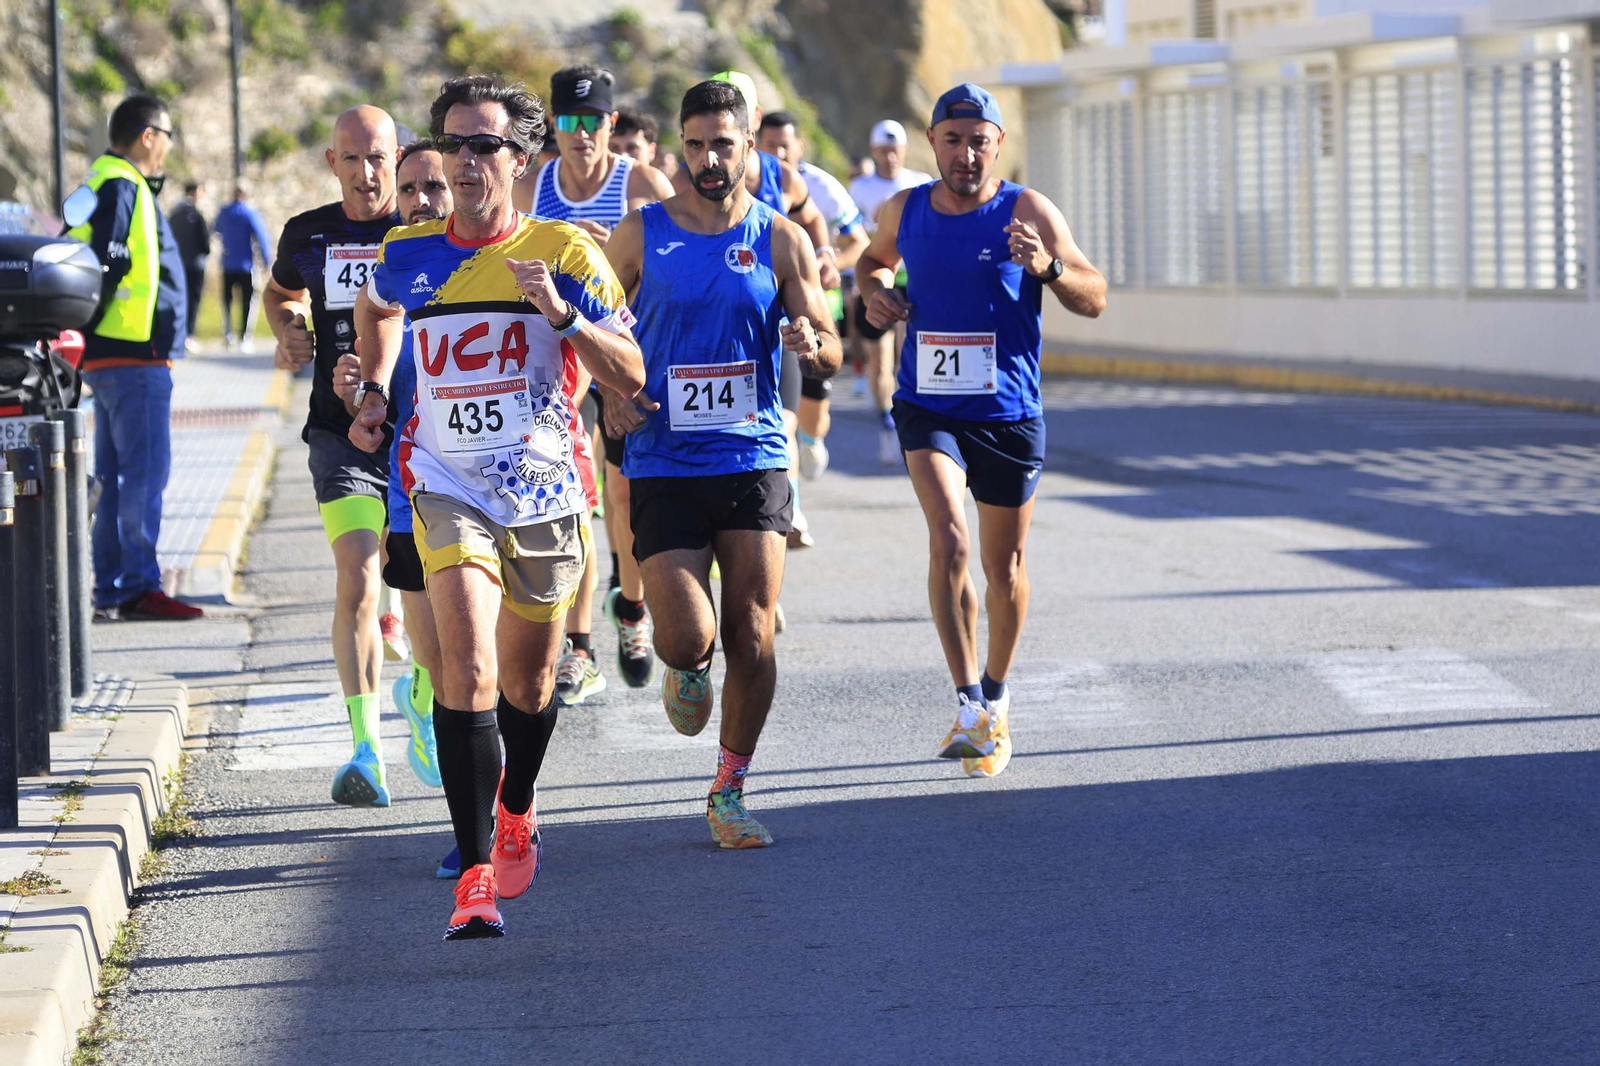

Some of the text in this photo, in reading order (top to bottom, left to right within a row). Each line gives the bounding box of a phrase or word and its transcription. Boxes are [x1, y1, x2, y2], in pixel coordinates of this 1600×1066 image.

[418, 321, 530, 377] UCA
[933, 348, 960, 376] 21
[447, 386, 475, 396] CARRERA
[475, 385, 488, 393] DEL
[488, 381, 525, 392] ESTRECHO
[683, 381, 735, 411] 214
[447, 399, 504, 435] 435
[467, 436, 486, 444] JAVIER
